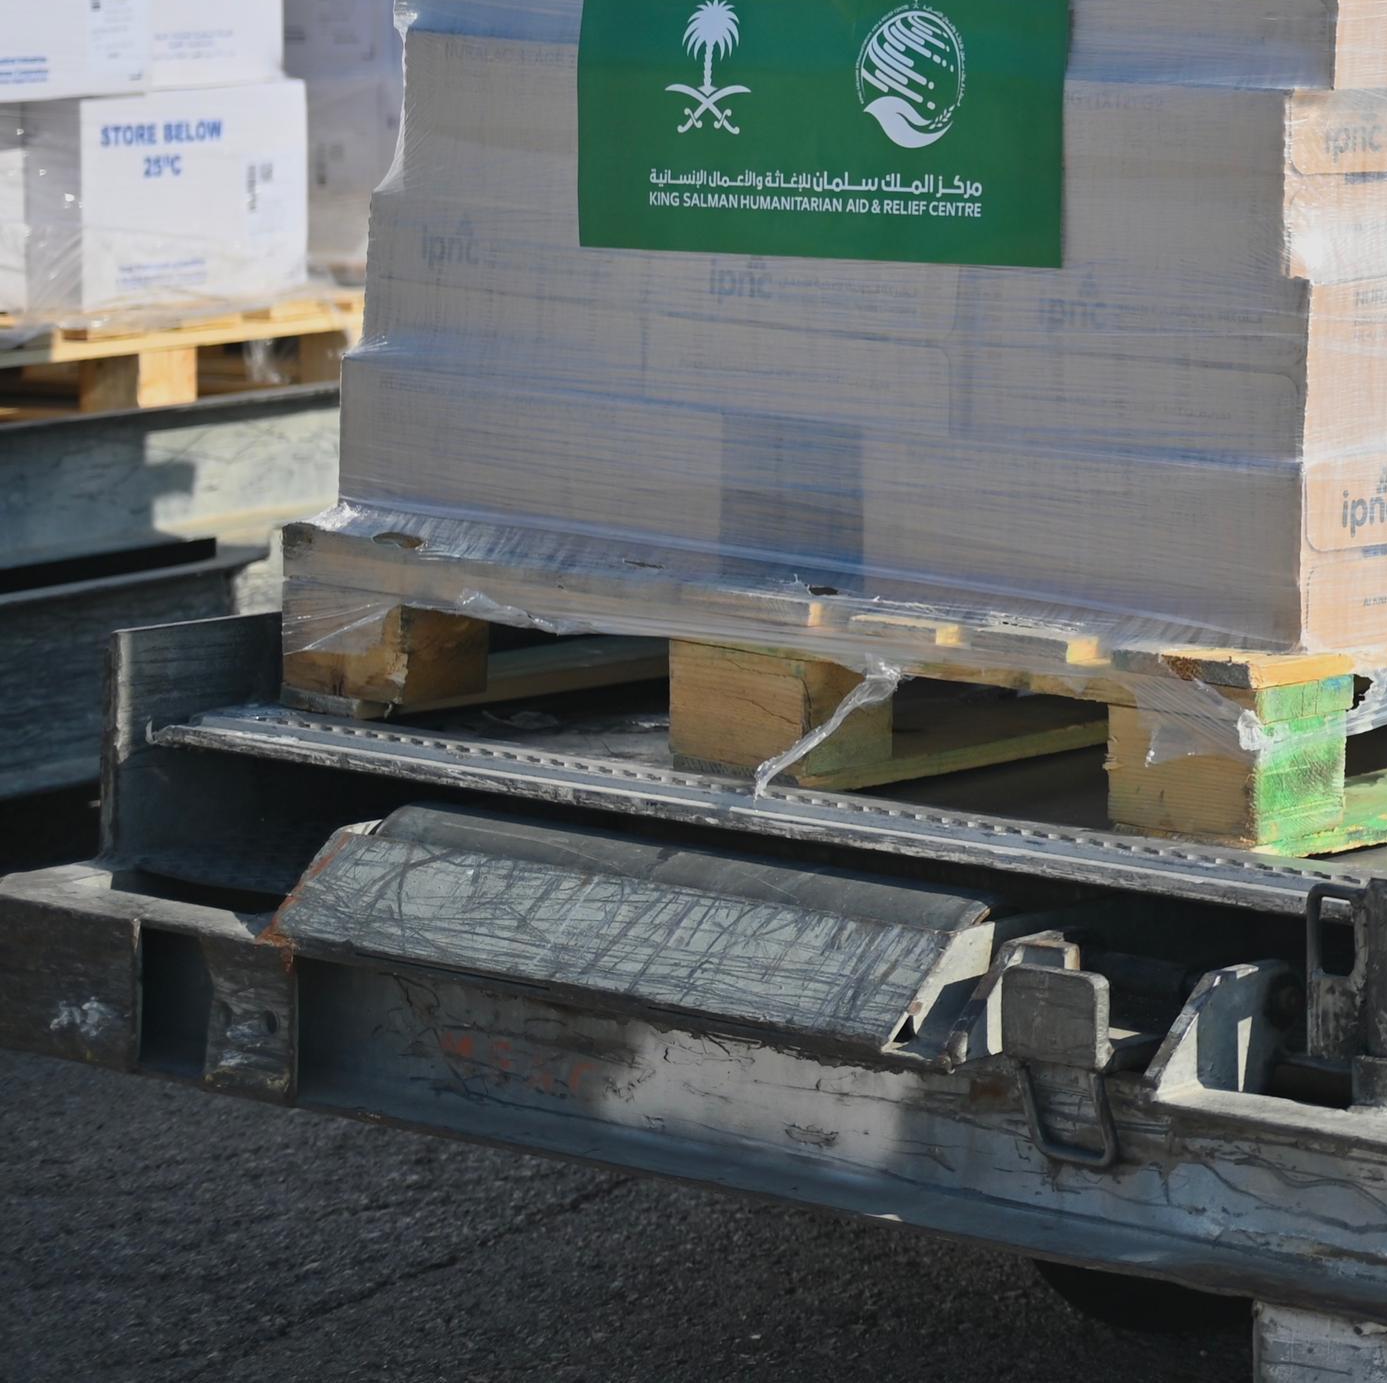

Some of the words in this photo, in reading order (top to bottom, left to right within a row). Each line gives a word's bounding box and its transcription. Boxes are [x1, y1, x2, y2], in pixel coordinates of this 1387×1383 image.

[100, 125, 157, 147] STORE
[163, 120, 222, 142] BELOW
[650, 168, 707, 187] الإنسانية
[709, 169, 764, 190] والأعمال
[765, 170, 811, 191] للإغاثة
[813, 172, 877, 192] سلمان
[882, 173, 933, 194] الملك
[935, 175, 982, 199] مركز
[650, 191, 680, 207] KING
[683, 193, 739, 209] SALMAN
[741, 194, 843, 211] HUMANITARIAN
[846, 198, 869, 213] AID
[871, 199, 882, 213] &
[884, 200, 927, 215] RELIEF
[929, 202, 982, 217] CENTRE
[708, 258, 773, 304] ipnc
